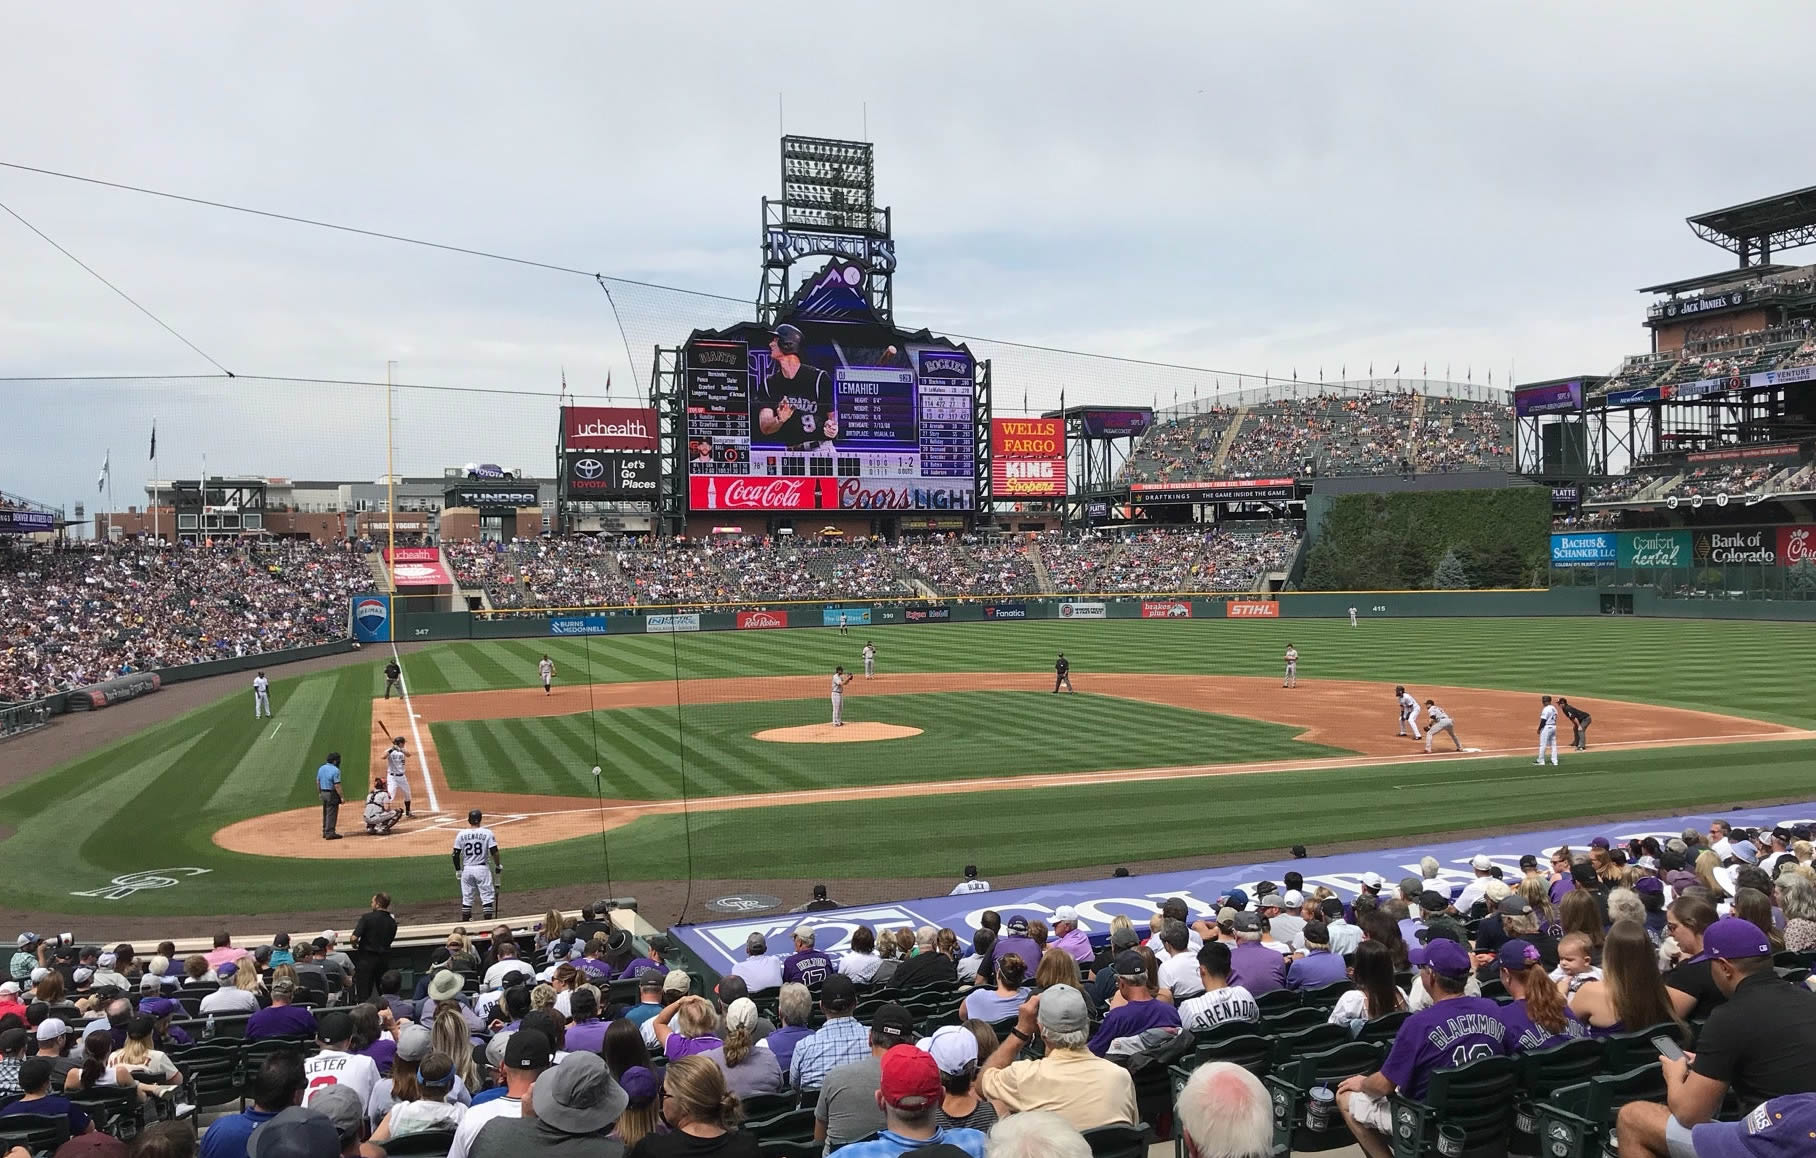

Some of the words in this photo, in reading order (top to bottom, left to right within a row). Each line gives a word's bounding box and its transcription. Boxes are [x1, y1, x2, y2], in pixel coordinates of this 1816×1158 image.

[767, 230, 896, 272] ROCKIES
[1681, 303, 1698, 314] JACK
[1700, 296, 1727, 311] DANIEL'S
[925, 358, 967, 374] ROCKIES
[1777, 368, 1810, 378] VENTURE
[838, 382, 879, 395] LEMAHIEU
[578, 419, 647, 437] uchealth
[801, 414, 817, 433] 9
[1002, 422, 1055, 435] WELLS
[1004, 440, 1055, 452] FARGO
[621, 460, 645, 469] Let's
[1006, 461, 1054, 477] KING
[475, 469, 504, 478] TOYOTA
[621, 470, 636, 479] Go
[572, 480, 607, 488] TOYOTA
[622, 480, 656, 489] Places
[1006, 477, 1054, 492] Soopers
[460, 493, 535, 502] TUNDRA
[725, 479, 805, 507] Coca-Cola
[839, 478, 912, 509] Coors
[915, 489, 975, 509] LIGHT
[1552, 489, 1576, 497] PLATTE
[1720, 496, 1726, 504] 17
[1562, 538, 1596, 549] BACHUS
[1596, 537, 1606, 548] &
[1633, 533, 1674, 550] Comfort
[1712, 532, 1744, 548] Bank
[1747, 531, 1762, 547] of
[395, 550, 430, 560] uchealth
[1553, 547, 1599, 559] SCHANKER
[1600, 548, 1616, 557] LLC
[1632, 545, 1680, 566] dental
[1712, 547, 1775, 563] Colorado
[360, 607, 384, 615] RE/MAX
[996, 609, 1025, 617] Fanatics
[1232, 605, 1273, 615] STIHL
[744, 617, 759, 628] Red
[760, 618, 781, 627] Robin
[460, 833, 487, 841] ARENADO
[464, 841, 483, 856] 28
[796, 958, 827, 971] HELTON
[802, 968, 827, 988] 17
[1195, 1000, 1254, 1028] ARENADO
[1428, 1014, 1506, 1051] BLACKMON
[306, 1059, 347, 1074] JETER
